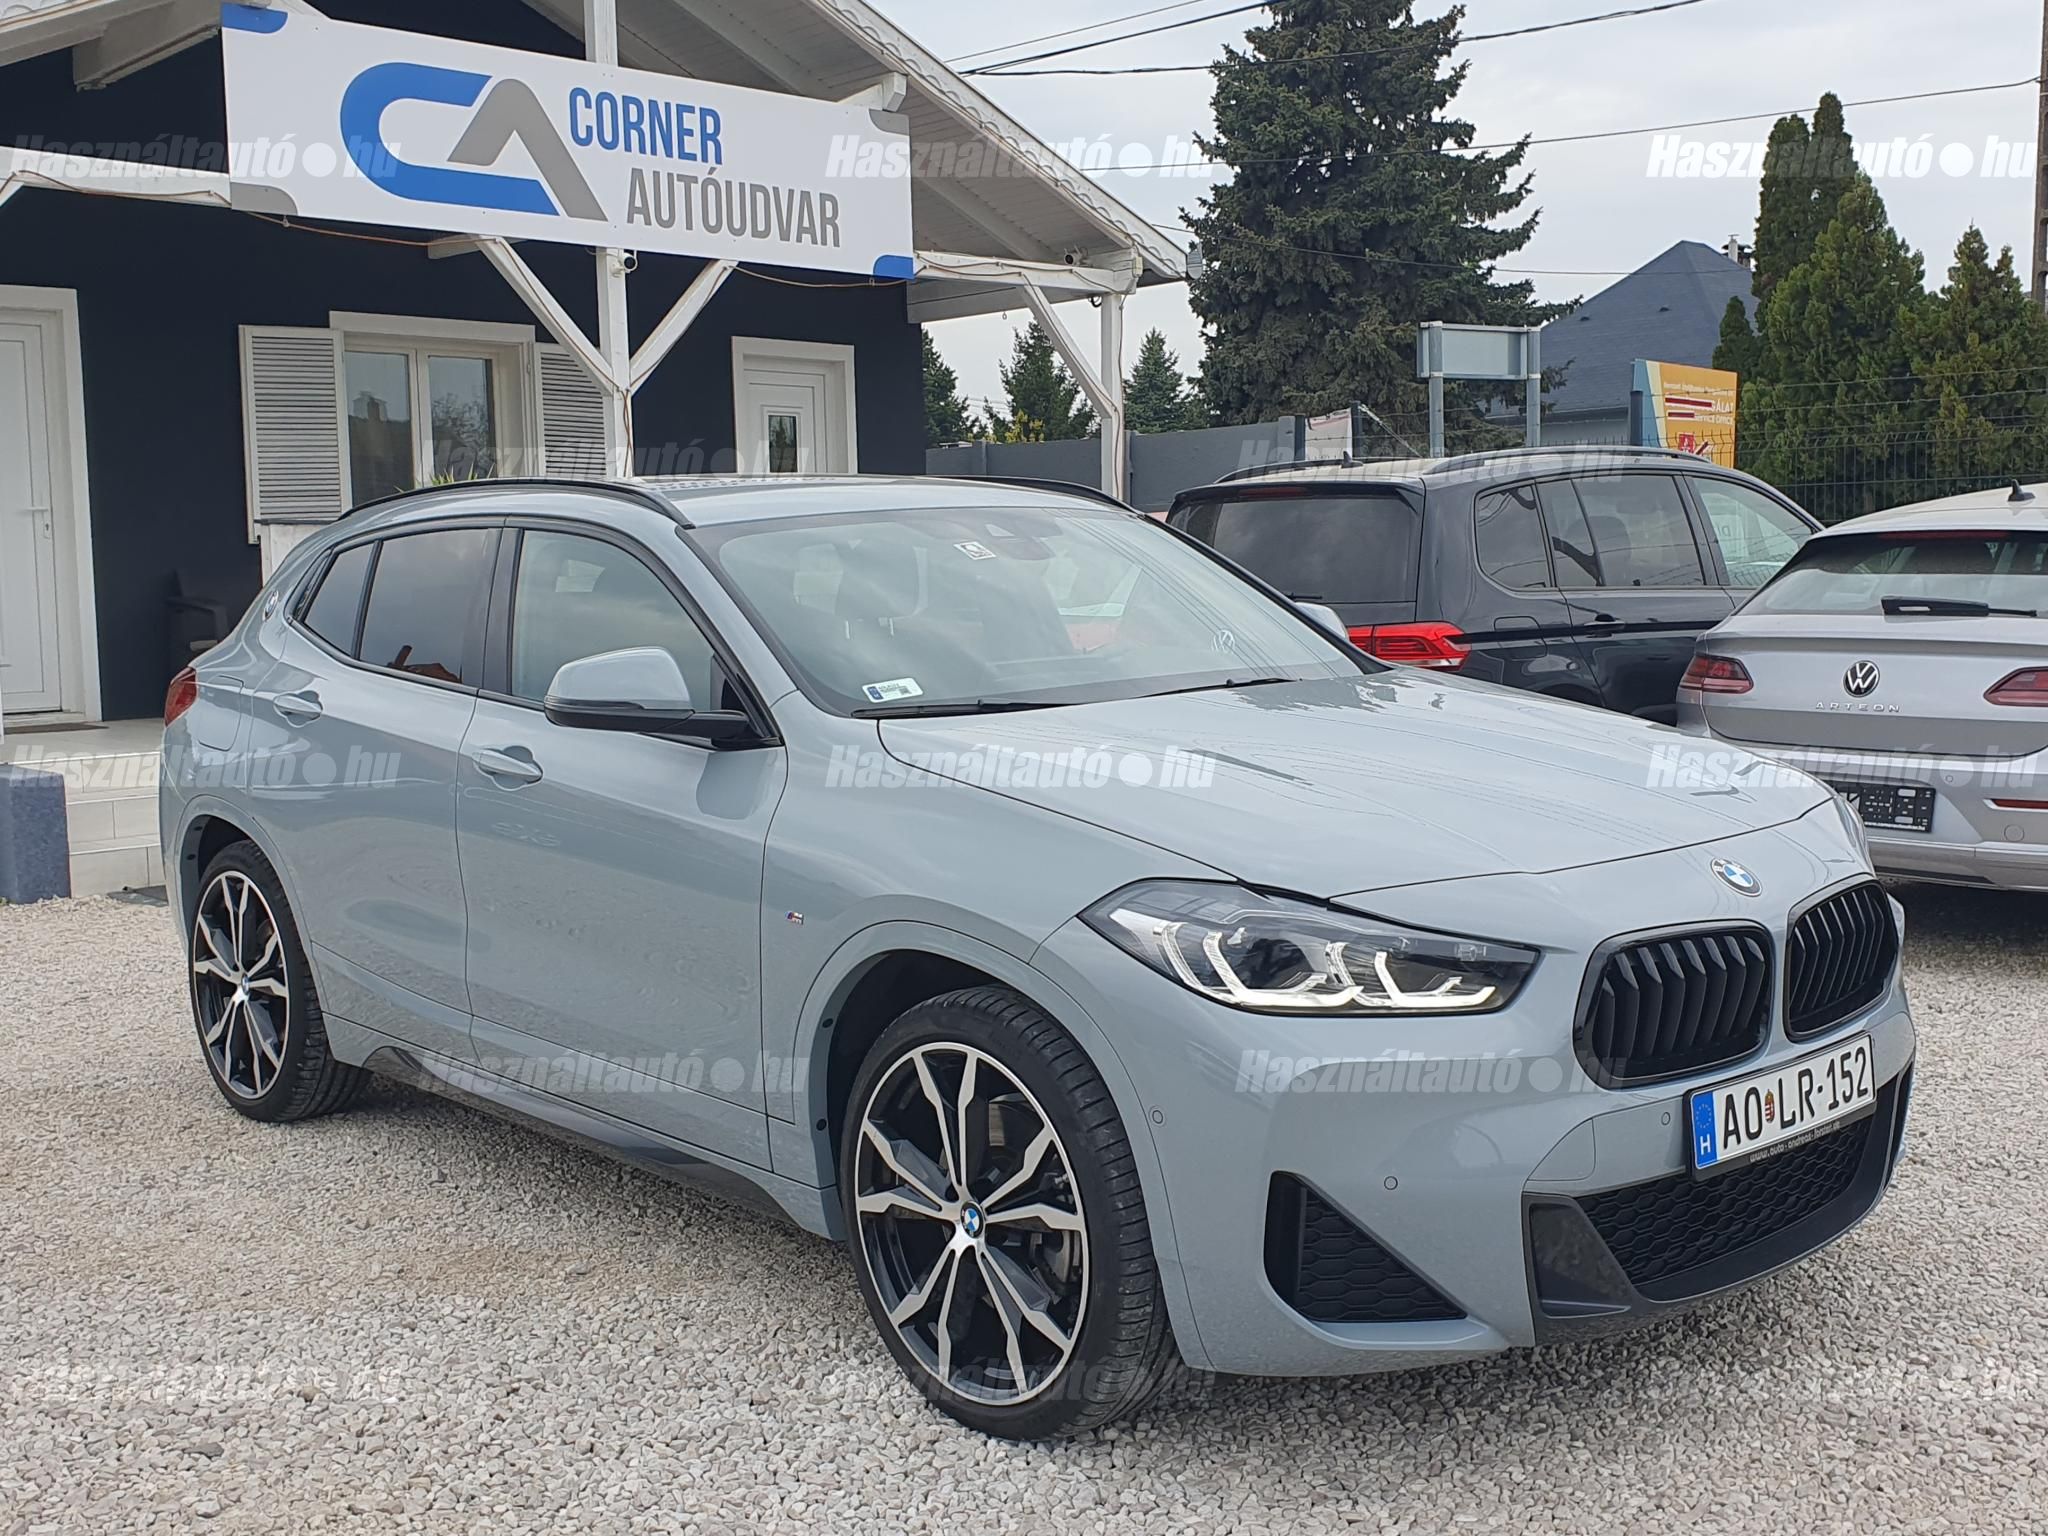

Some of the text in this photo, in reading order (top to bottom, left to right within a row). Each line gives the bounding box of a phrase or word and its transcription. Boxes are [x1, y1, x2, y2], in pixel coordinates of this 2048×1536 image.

[568, 86, 722, 166] CORNER
[626, 167, 841, 248] AUTÓUDVAR
[1815, 702, 1901, 713] ARTEON
[1699, 1134, 1712, 1156] H
